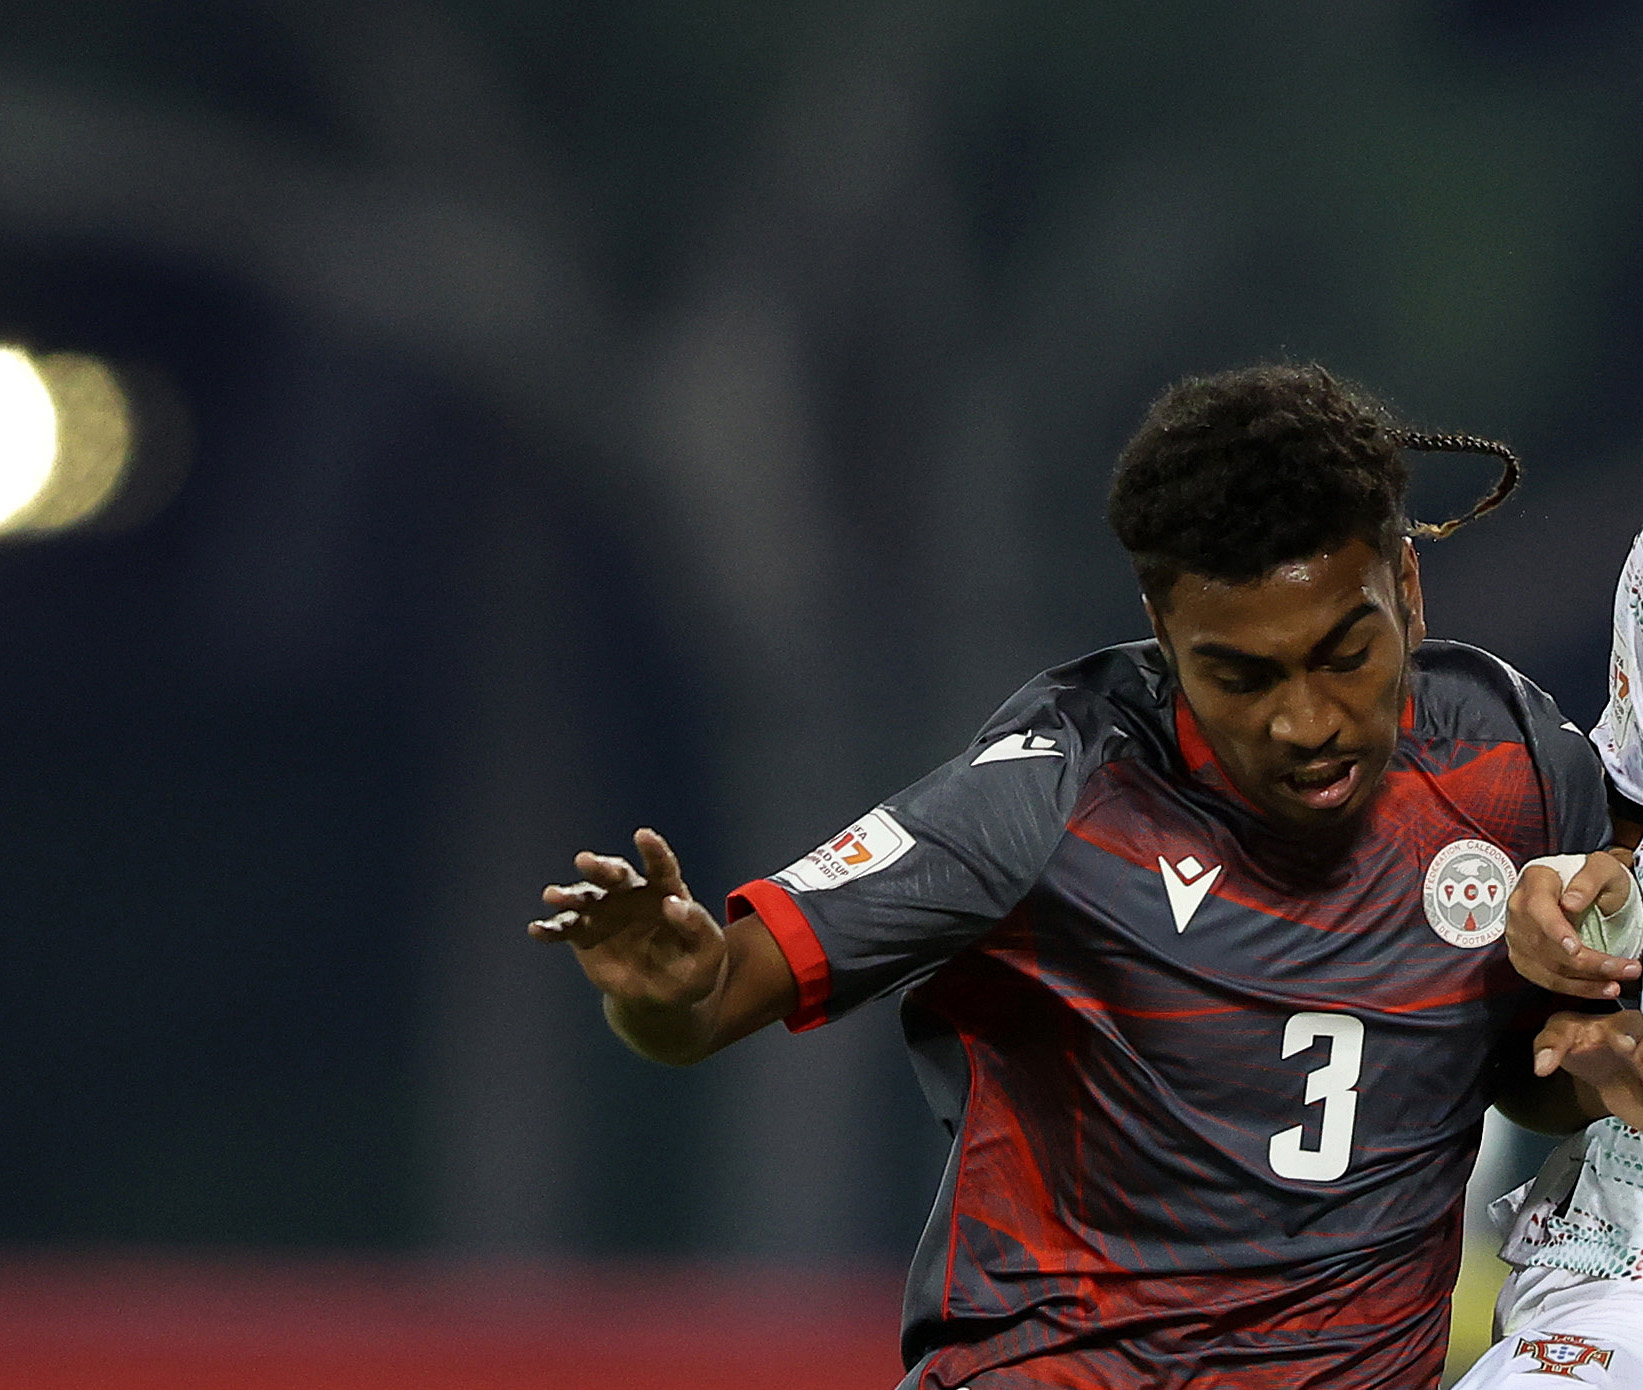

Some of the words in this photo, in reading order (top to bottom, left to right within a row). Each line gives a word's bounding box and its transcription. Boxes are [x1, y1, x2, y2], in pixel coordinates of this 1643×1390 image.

[828, 830, 873, 866] 17
[830, 860, 850, 876] CUP
[1455, 926, 1502, 945] FOOTBALL
[1268, 1010, 1365, 1183] 3
